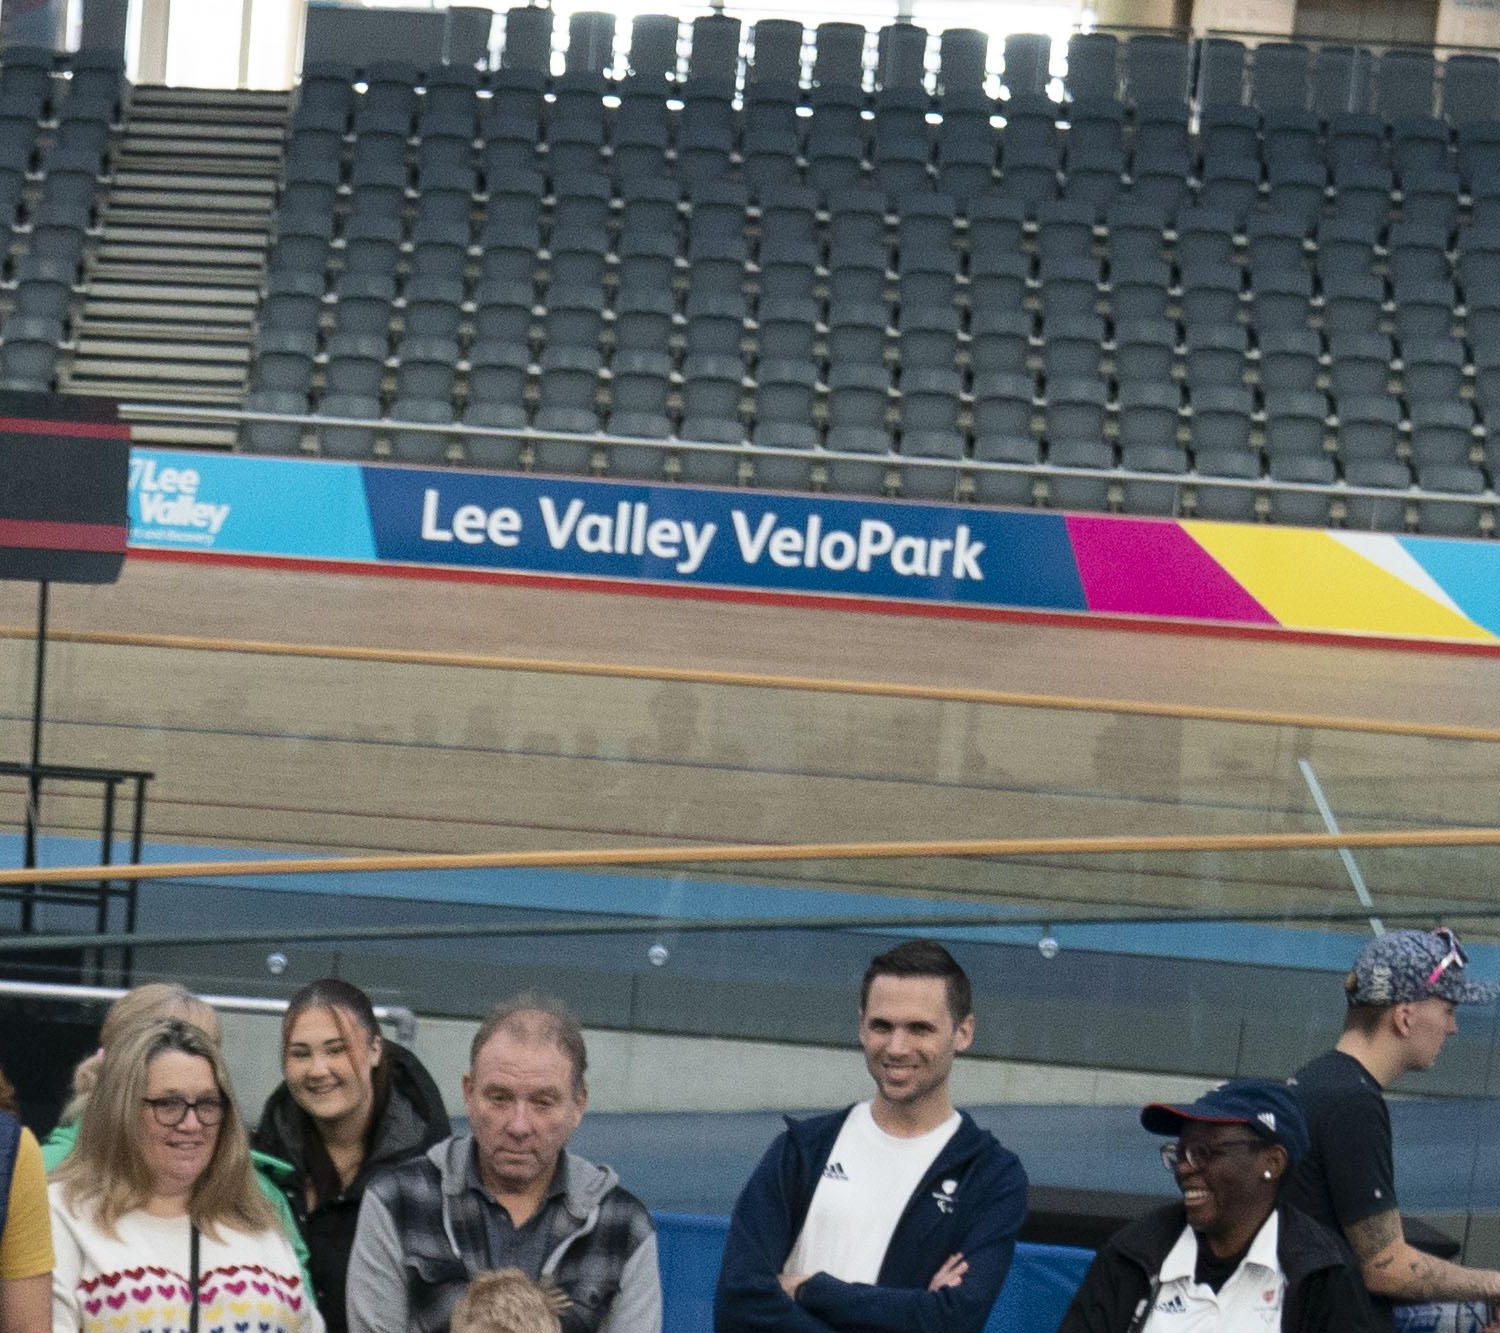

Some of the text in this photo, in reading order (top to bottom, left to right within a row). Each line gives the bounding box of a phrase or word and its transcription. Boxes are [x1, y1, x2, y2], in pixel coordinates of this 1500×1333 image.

[141, 459, 200, 493] Lee
[139, 492, 231, 534] Valley
[421, 488, 986, 580] Lee Valley VeloPark
